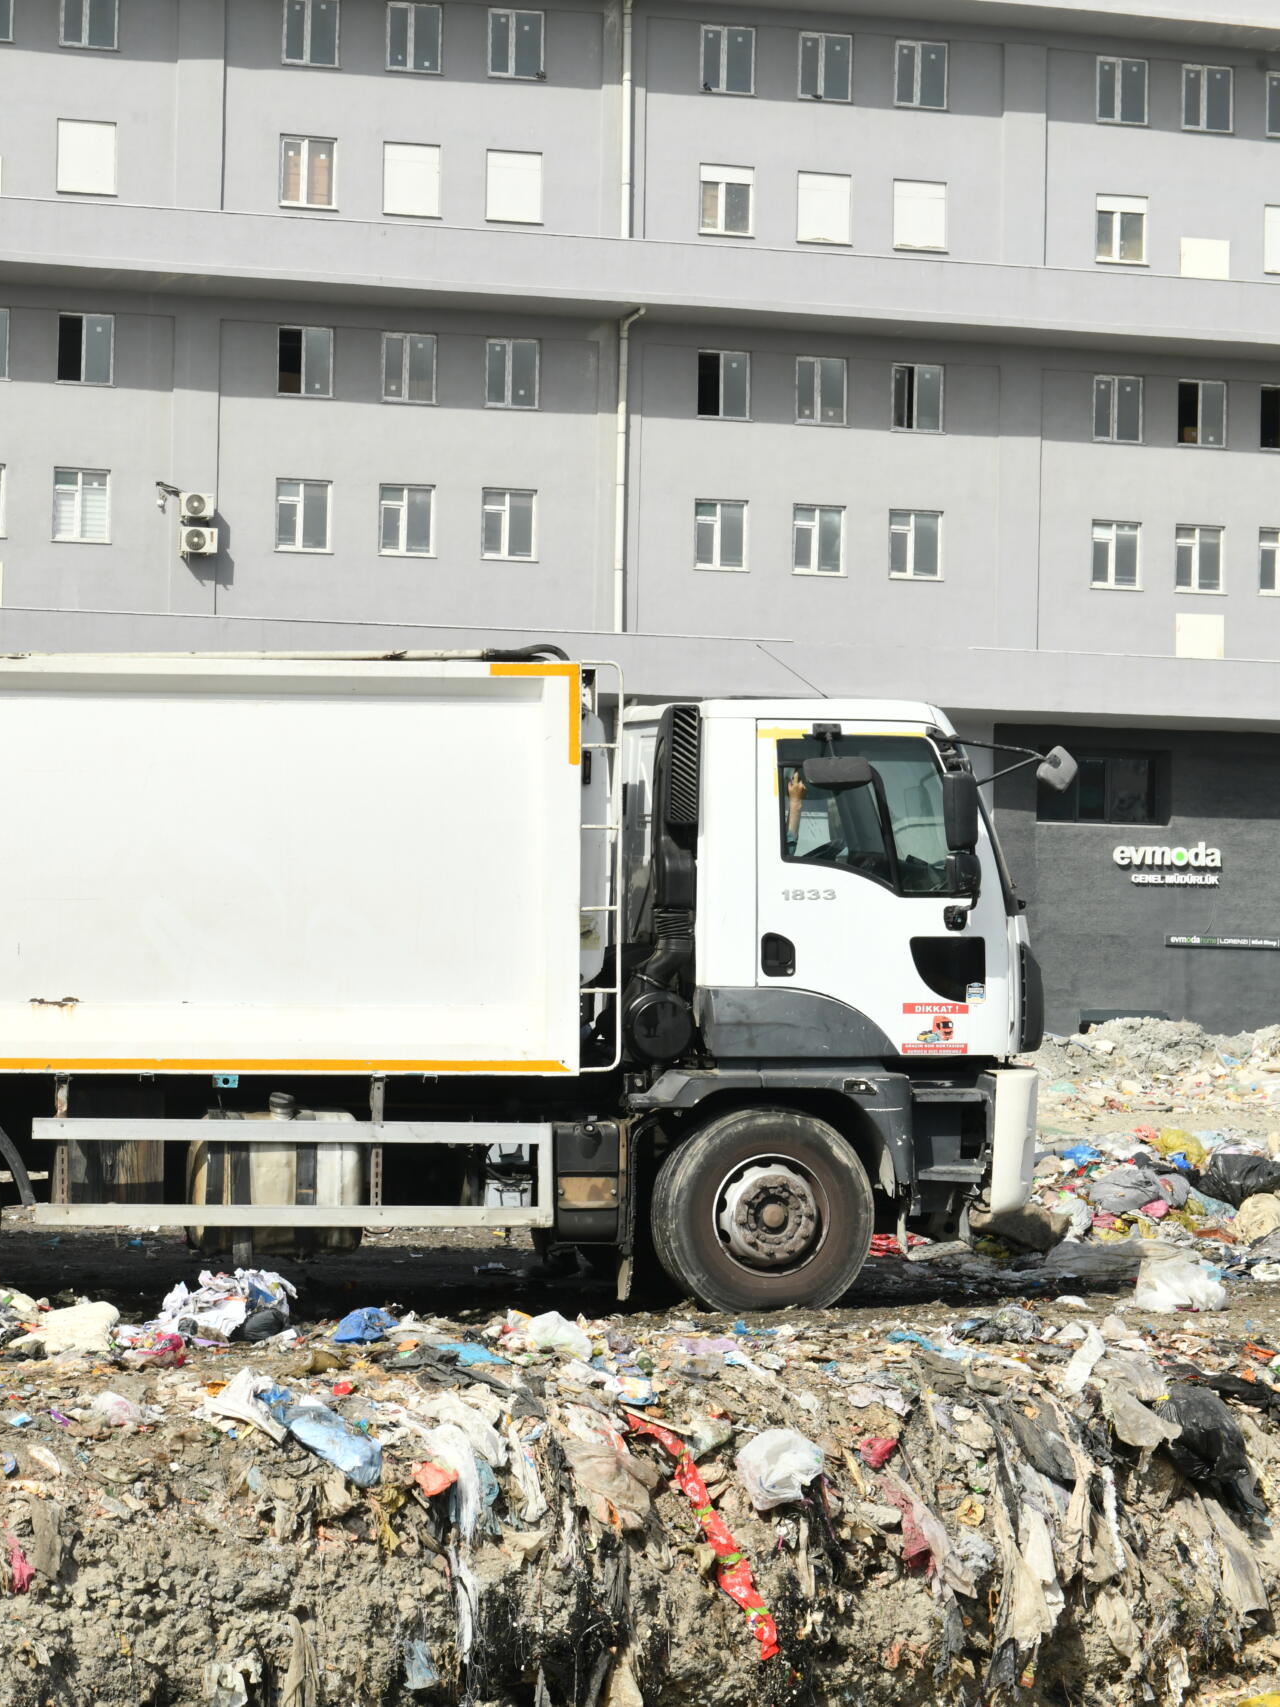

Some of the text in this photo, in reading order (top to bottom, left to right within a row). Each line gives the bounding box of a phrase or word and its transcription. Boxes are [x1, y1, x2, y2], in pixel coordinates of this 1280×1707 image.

[1113, 841, 1222, 868] evmoda
[1131, 873, 1165, 884] GENEL
[782, 889, 837, 901] 1833
[914, 1004, 953, 1013] DİKKAT
